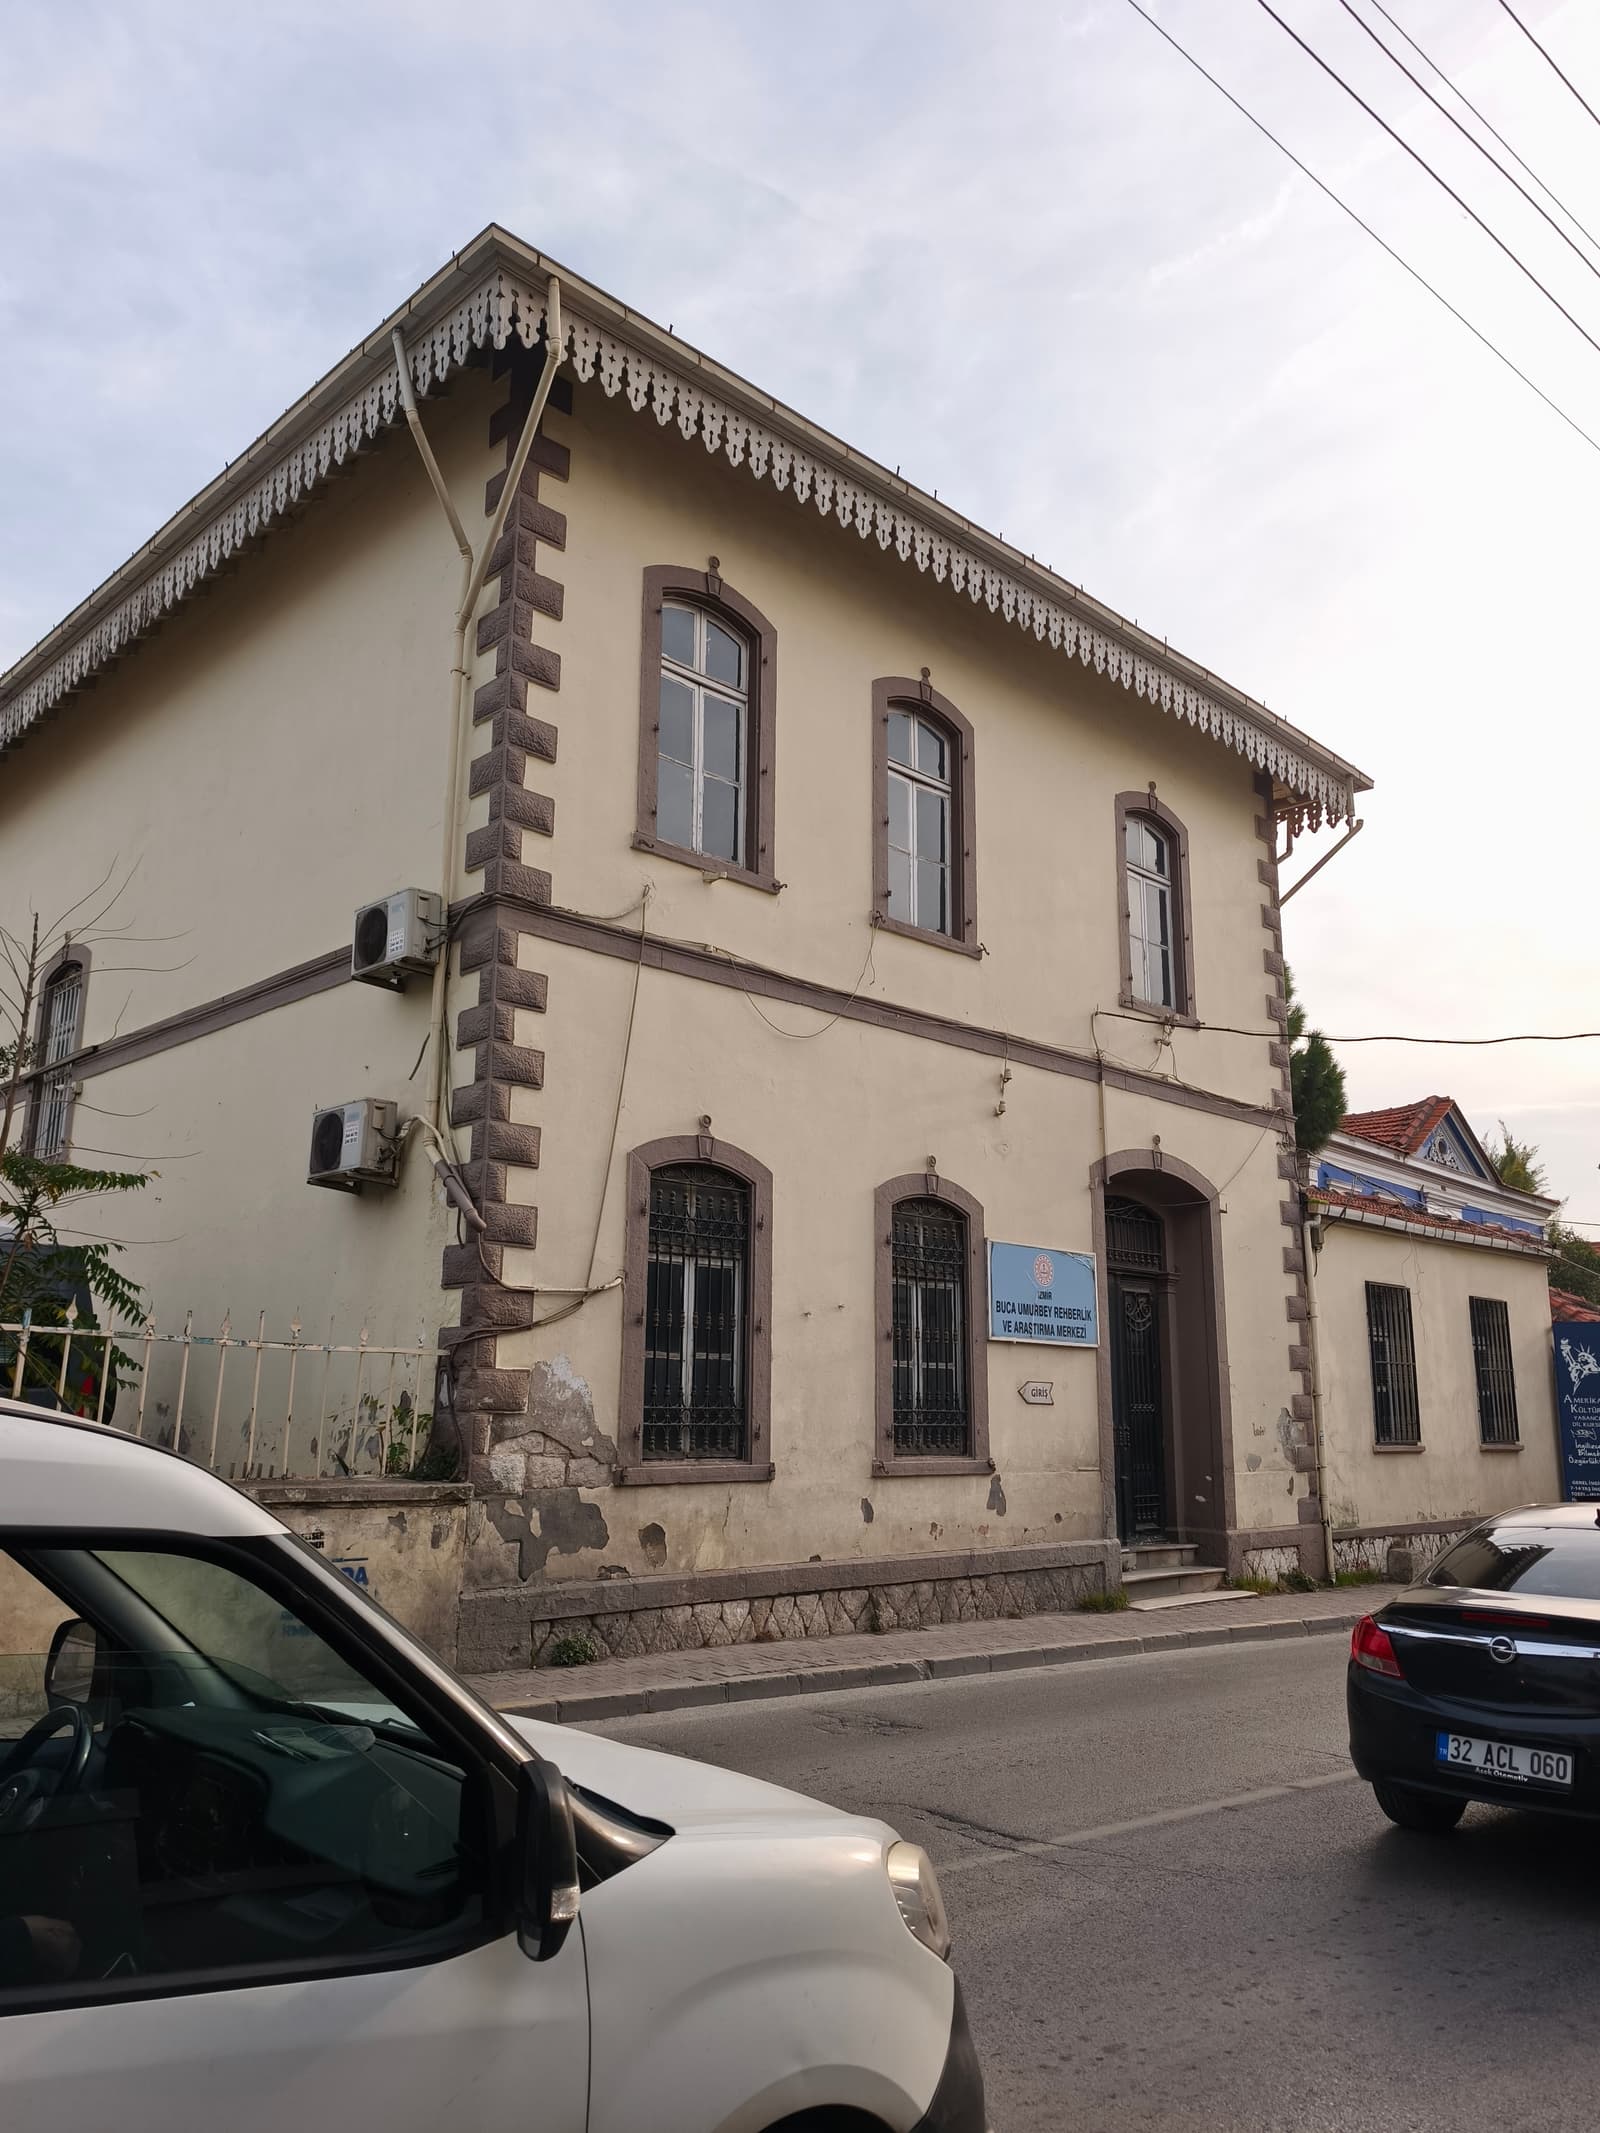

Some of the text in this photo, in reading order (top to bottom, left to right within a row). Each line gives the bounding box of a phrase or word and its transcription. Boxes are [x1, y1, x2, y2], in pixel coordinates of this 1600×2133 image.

[996, 1300, 1092, 1322] BUCA UMURBEY REHBERLİK
[1002, 1319, 1087, 1339] VE ARAŞTIRMA MERKEZİ
[1031, 1386, 1048, 1399] GİRİŞ
[1450, 1737, 1568, 1780] 32 ACL 060
